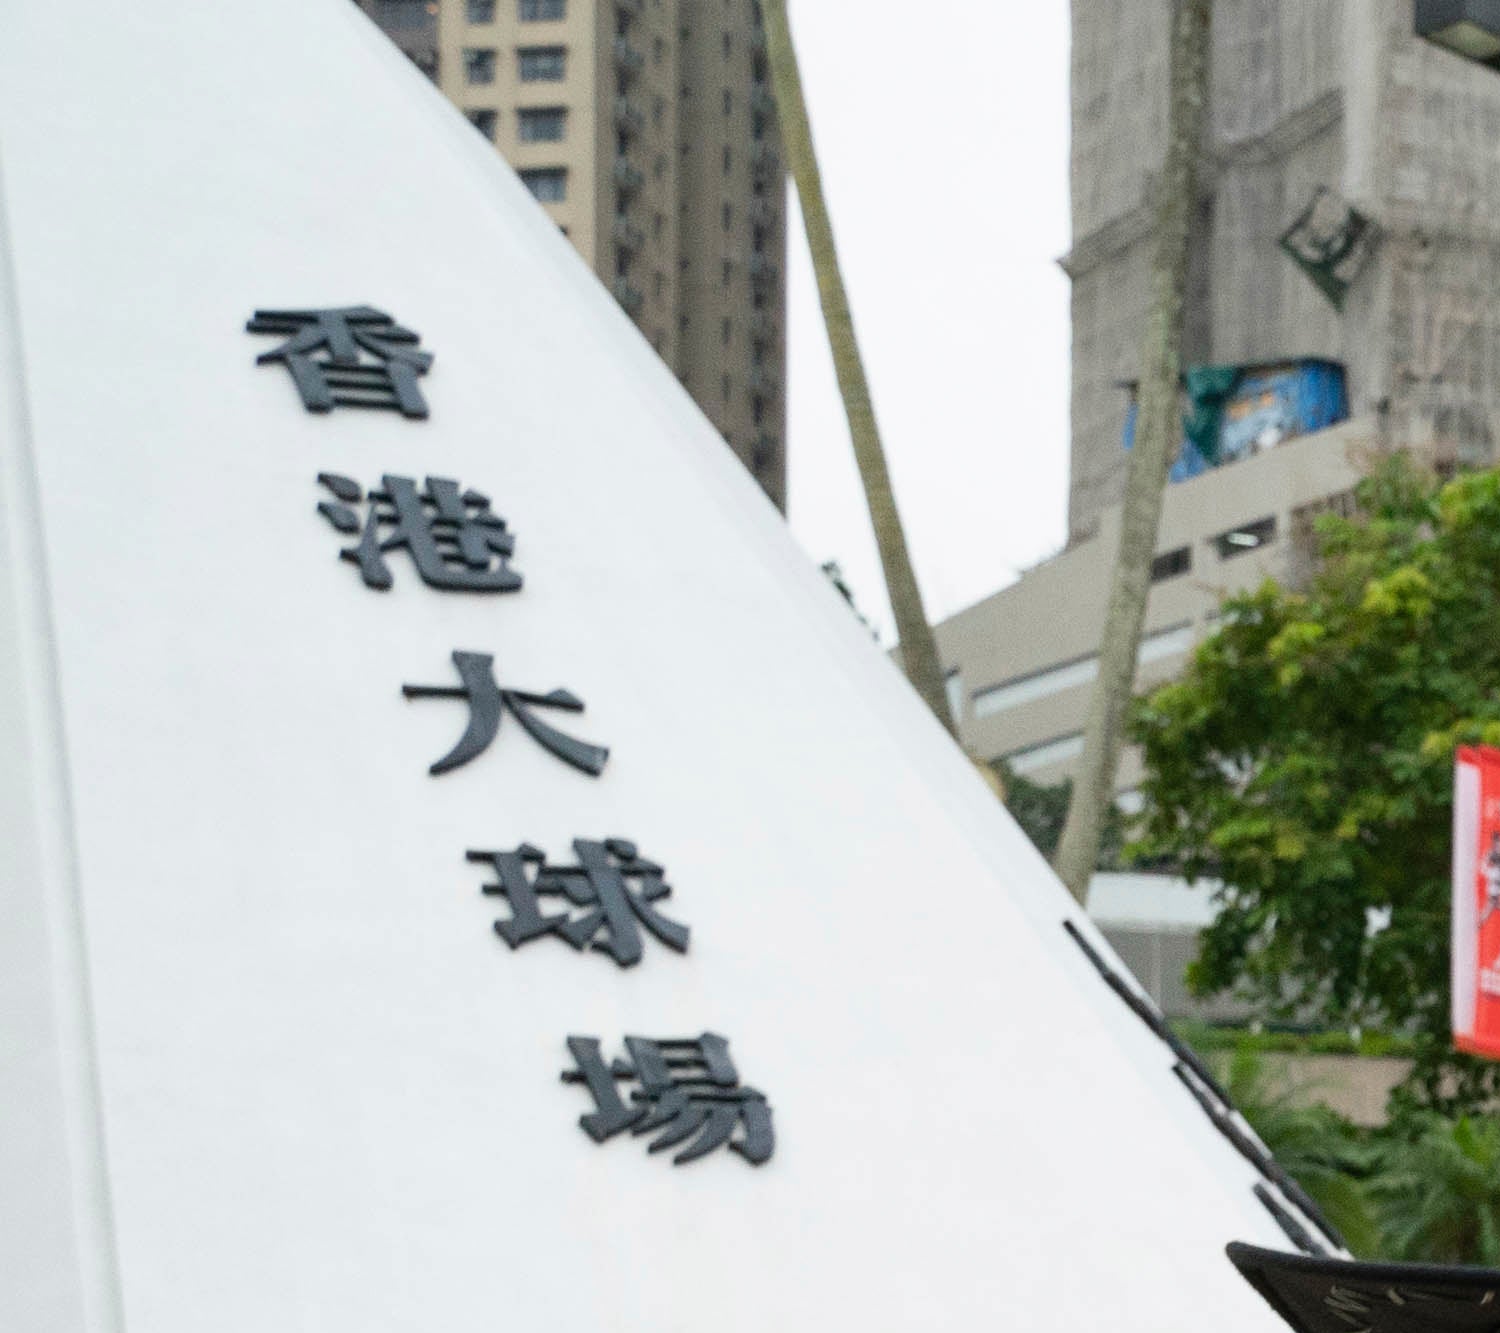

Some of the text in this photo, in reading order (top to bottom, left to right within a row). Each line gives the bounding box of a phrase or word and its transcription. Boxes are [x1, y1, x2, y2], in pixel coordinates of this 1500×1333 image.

[246, 305, 777, 1167] 香港大球場
